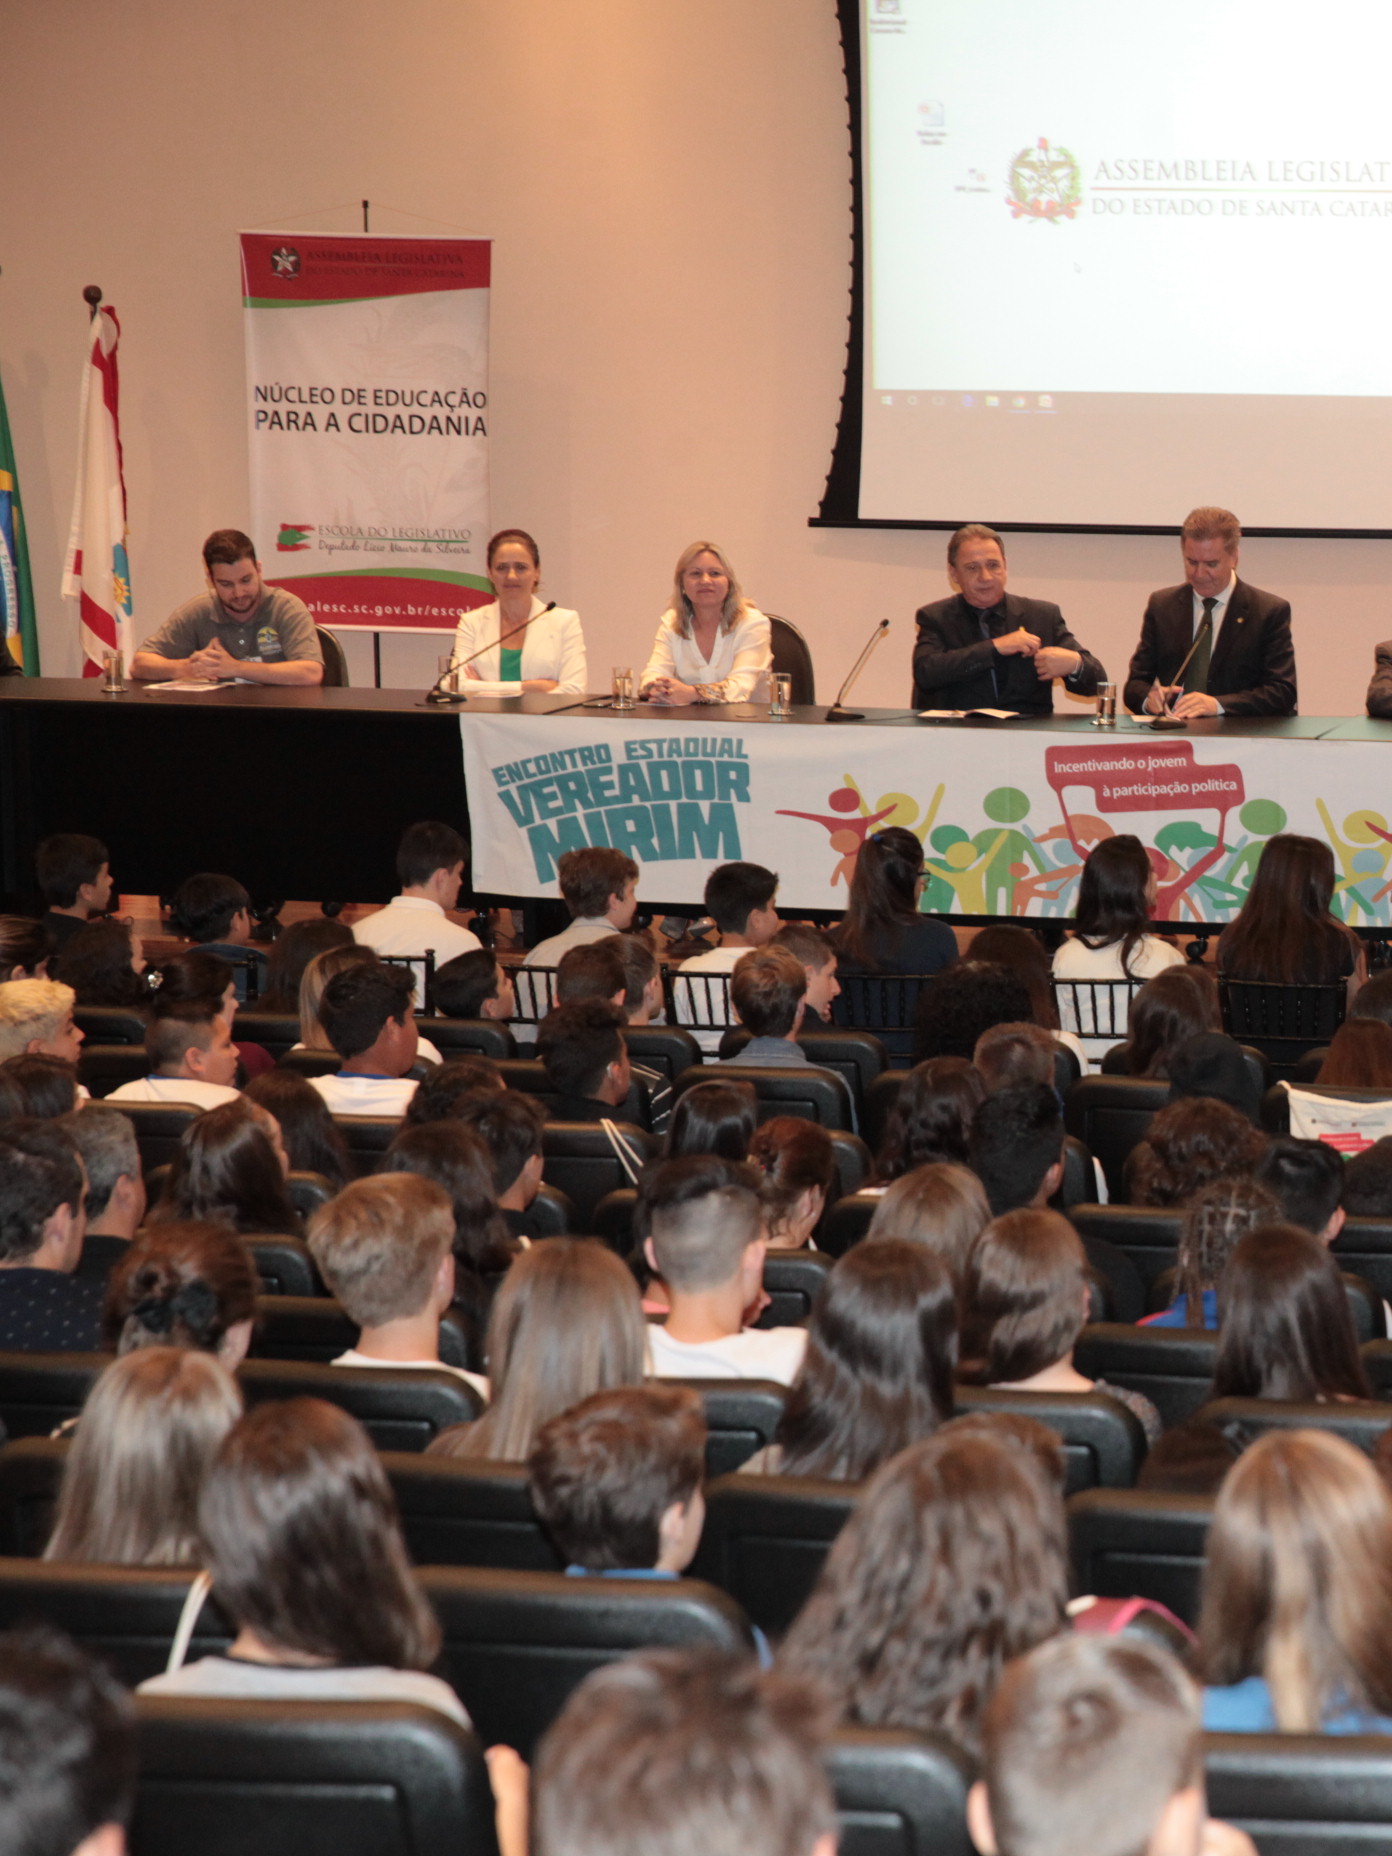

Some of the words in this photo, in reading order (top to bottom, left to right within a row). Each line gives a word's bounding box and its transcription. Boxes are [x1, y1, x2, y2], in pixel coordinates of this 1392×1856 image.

[1093, 159, 1256, 182] ASSEMBLEIA
[1091, 197, 1124, 215] DO
[1132, 197, 1213, 216] ESTADO
[1221, 199, 1248, 216] DE
[1255, 199, 1322, 217] SANTA
[255, 382, 336, 406] NÚCLEO
[341, 387, 367, 406] DE
[373, 387, 488, 413] EDUCAÇÃO
[255, 409, 317, 433] PARA
[324, 411, 341, 433] A
[347, 412, 488, 437] CIDADANIA
[318, 524, 364, 538] ESCOLA
[368, 526, 388, 538] DO
[392, 527, 472, 541] LEGISLATIVO
[318, 539, 361, 556] Deputado
[491, 743, 613, 788] ENCONTRO
[624, 737, 749, 761] ESTADUAL
[1054, 757, 1135, 774] Incentivando
[1137, 759, 1146, 770] o
[1147, 756, 1187, 772] jovem
[497, 760, 752, 828] VEREADOR
[1102, 786, 1111, 798] à
[1112, 782, 1189, 800] participação
[1191, 779, 1238, 795] política
[526, 802, 742, 885] MIRIM
